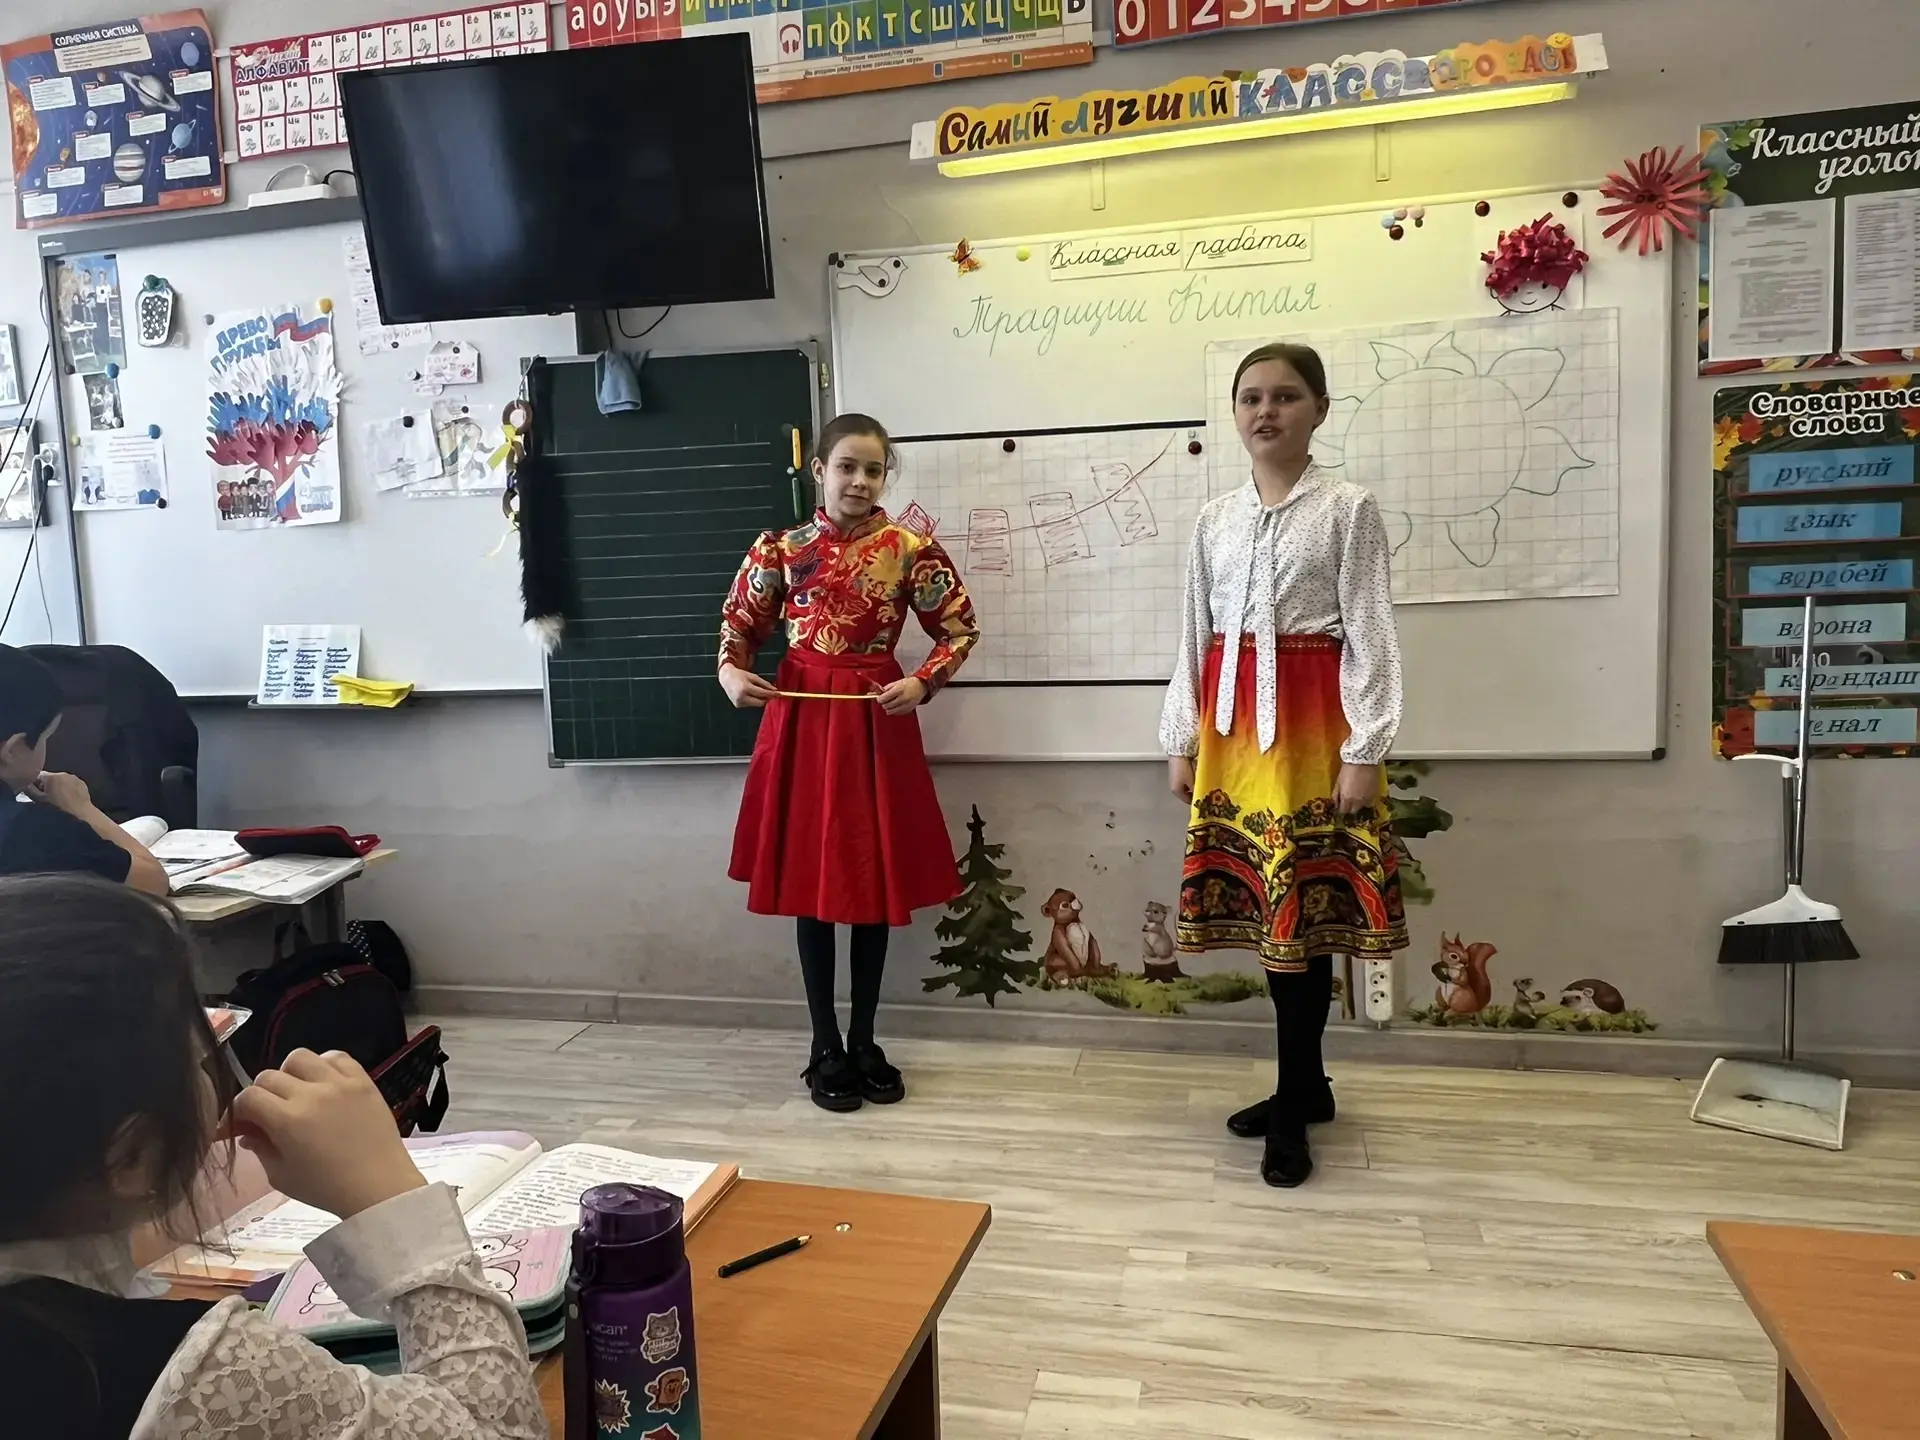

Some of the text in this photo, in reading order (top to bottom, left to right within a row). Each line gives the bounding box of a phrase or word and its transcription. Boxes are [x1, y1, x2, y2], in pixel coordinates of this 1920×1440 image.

[571, 5, 586, 31] а
[592, 1, 608, 27] о
[615, 0, 629, 32] у
[806, 23, 823, 49] п
[829, 11, 851, 54] ф
[856, 15, 873, 42] к
[882, 12, 898, 37] т
[909, 8, 924, 34] с
[931, 4, 954, 32] ш
[960, 2, 977, 28] х
[985, 0, 1005, 29] ц
[1118, 0, 1147, 36] 0
[1164, 0, 1178, 30] 1
[1191, 0, 1220, 27] 2
[55, 24, 139, 47] СОЛНЕЧНАЯ СИСТЕМА
[235, 59, 309, 84] АЛФАВИТ
[939, 101, 1052, 156] Самый
[1060, 80, 1229, 136] лучший
[1238, 58, 1405, 118] КЛАСС
[1749, 113, 1920, 160] Классный
[1049, 224, 1308, 271] Классная работа
[215, 315, 269, 354] ДРЕВО
[952, 294, 1149, 357] Традиции
[1750, 387, 1920, 418] Словарные
[1790, 412, 1885, 438] слова
[1773, 457, 1894, 487] русский
[1784, 513, 1857, 532] язык
[1775, 562, 1891, 588] воробей
[1794, 718, 1882, 737] енал
